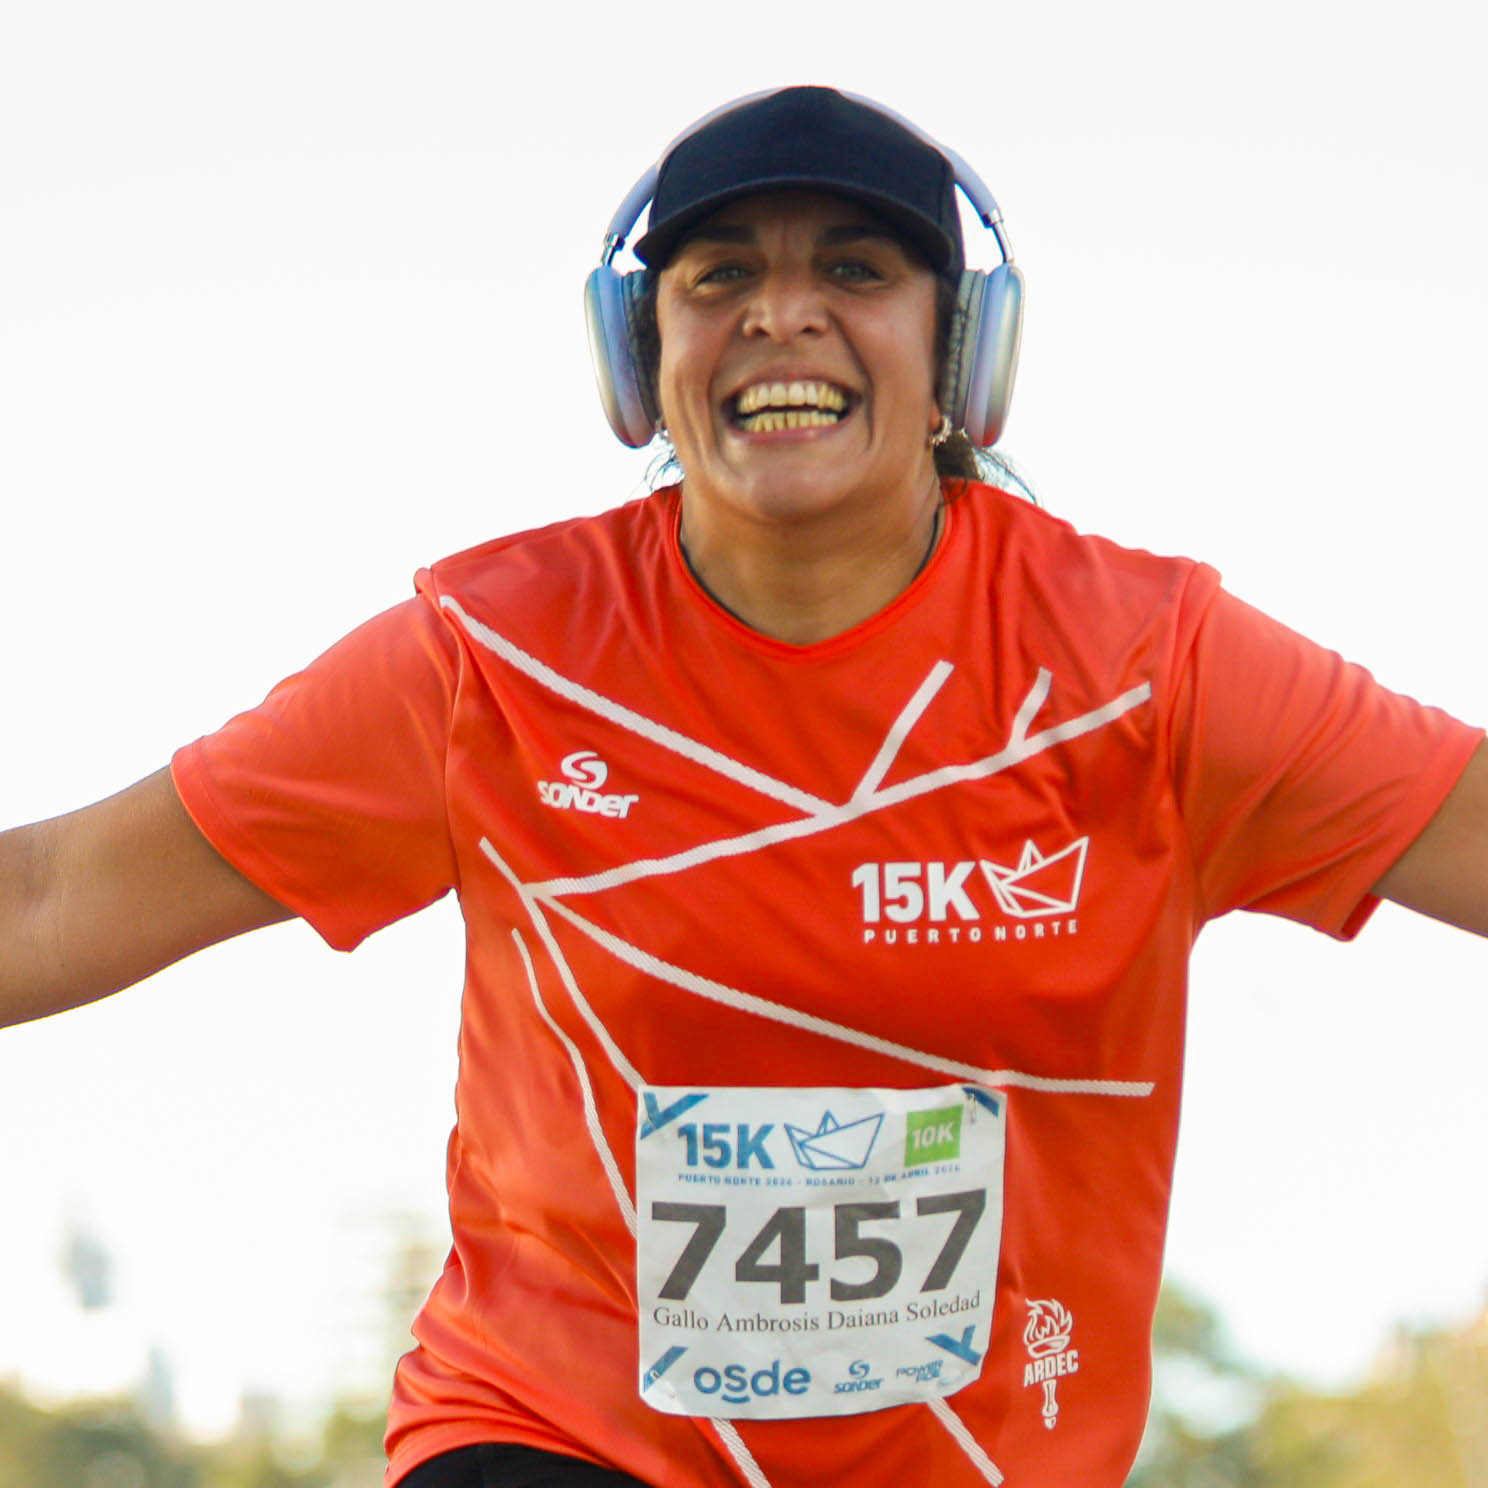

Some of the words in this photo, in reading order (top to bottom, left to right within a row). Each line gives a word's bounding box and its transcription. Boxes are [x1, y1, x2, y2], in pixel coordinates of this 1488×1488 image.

[852, 862, 981, 923] 15K
[863, 928, 982, 944] PUERTO
[994, 919, 1078, 941] NORTE
[677, 1123, 776, 1169] 15K
[912, 1122, 954, 1149] 10K
[678, 1174, 721, 1184] PUERTO
[724, 1175, 760, 1186] NORTE
[652, 1188, 987, 1304] 7457
[653, 1306, 709, 1331] Gallo
[716, 1311, 821, 1332] Ambrosis
[828, 1310, 900, 1330] Daiana
[906, 1289, 981, 1321] Soledad
[694, 1359, 811, 1397] osde
[1023, 1349, 1079, 1388] ARDEC
